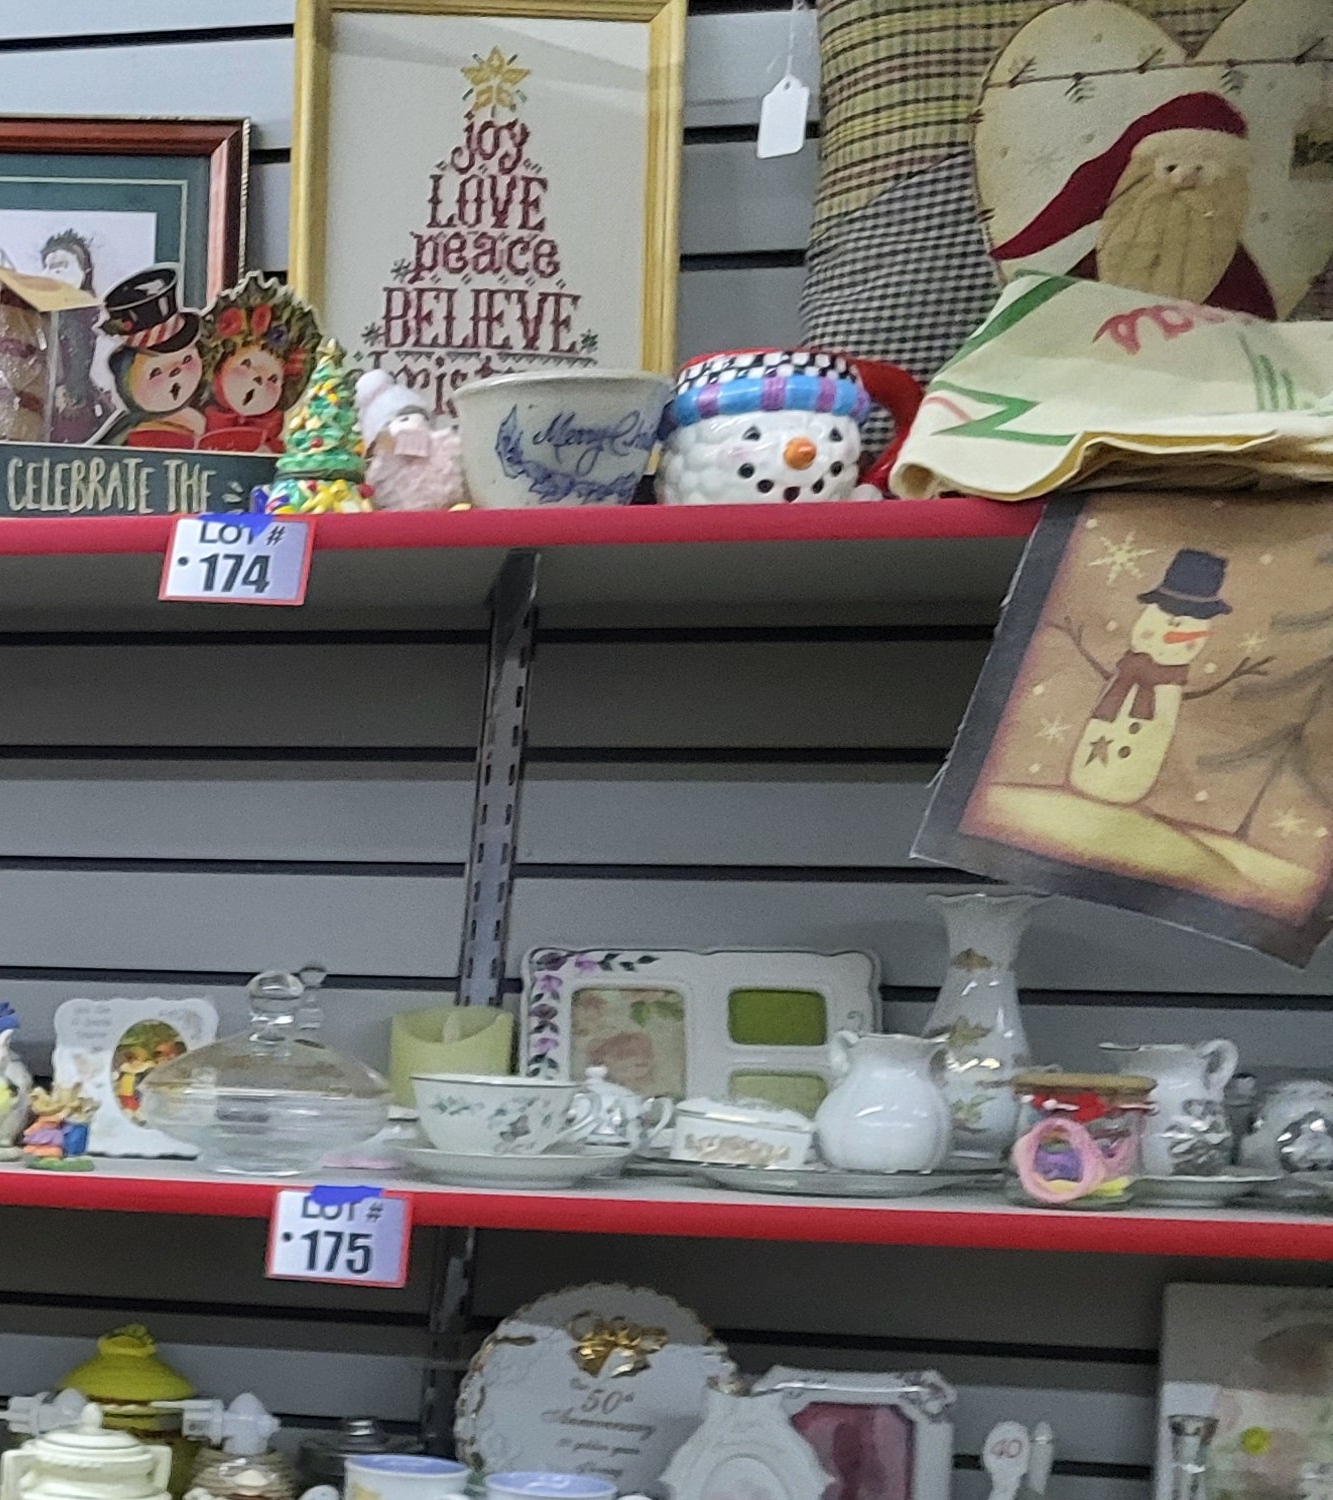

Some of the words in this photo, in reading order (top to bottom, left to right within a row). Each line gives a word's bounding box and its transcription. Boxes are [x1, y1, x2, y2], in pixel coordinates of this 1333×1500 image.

[451, 111, 530, 174] joy
[427, 174, 549, 231] LOVE
[408, 231, 561, 283] peace
[382, 286, 582, 353] BELIEVE
[7, 456, 155, 514] CELEBRATE
[162, 459, 217, 513] THE
[199, 553, 271, 593] 174
[301, 1229, 373, 1275] 175
